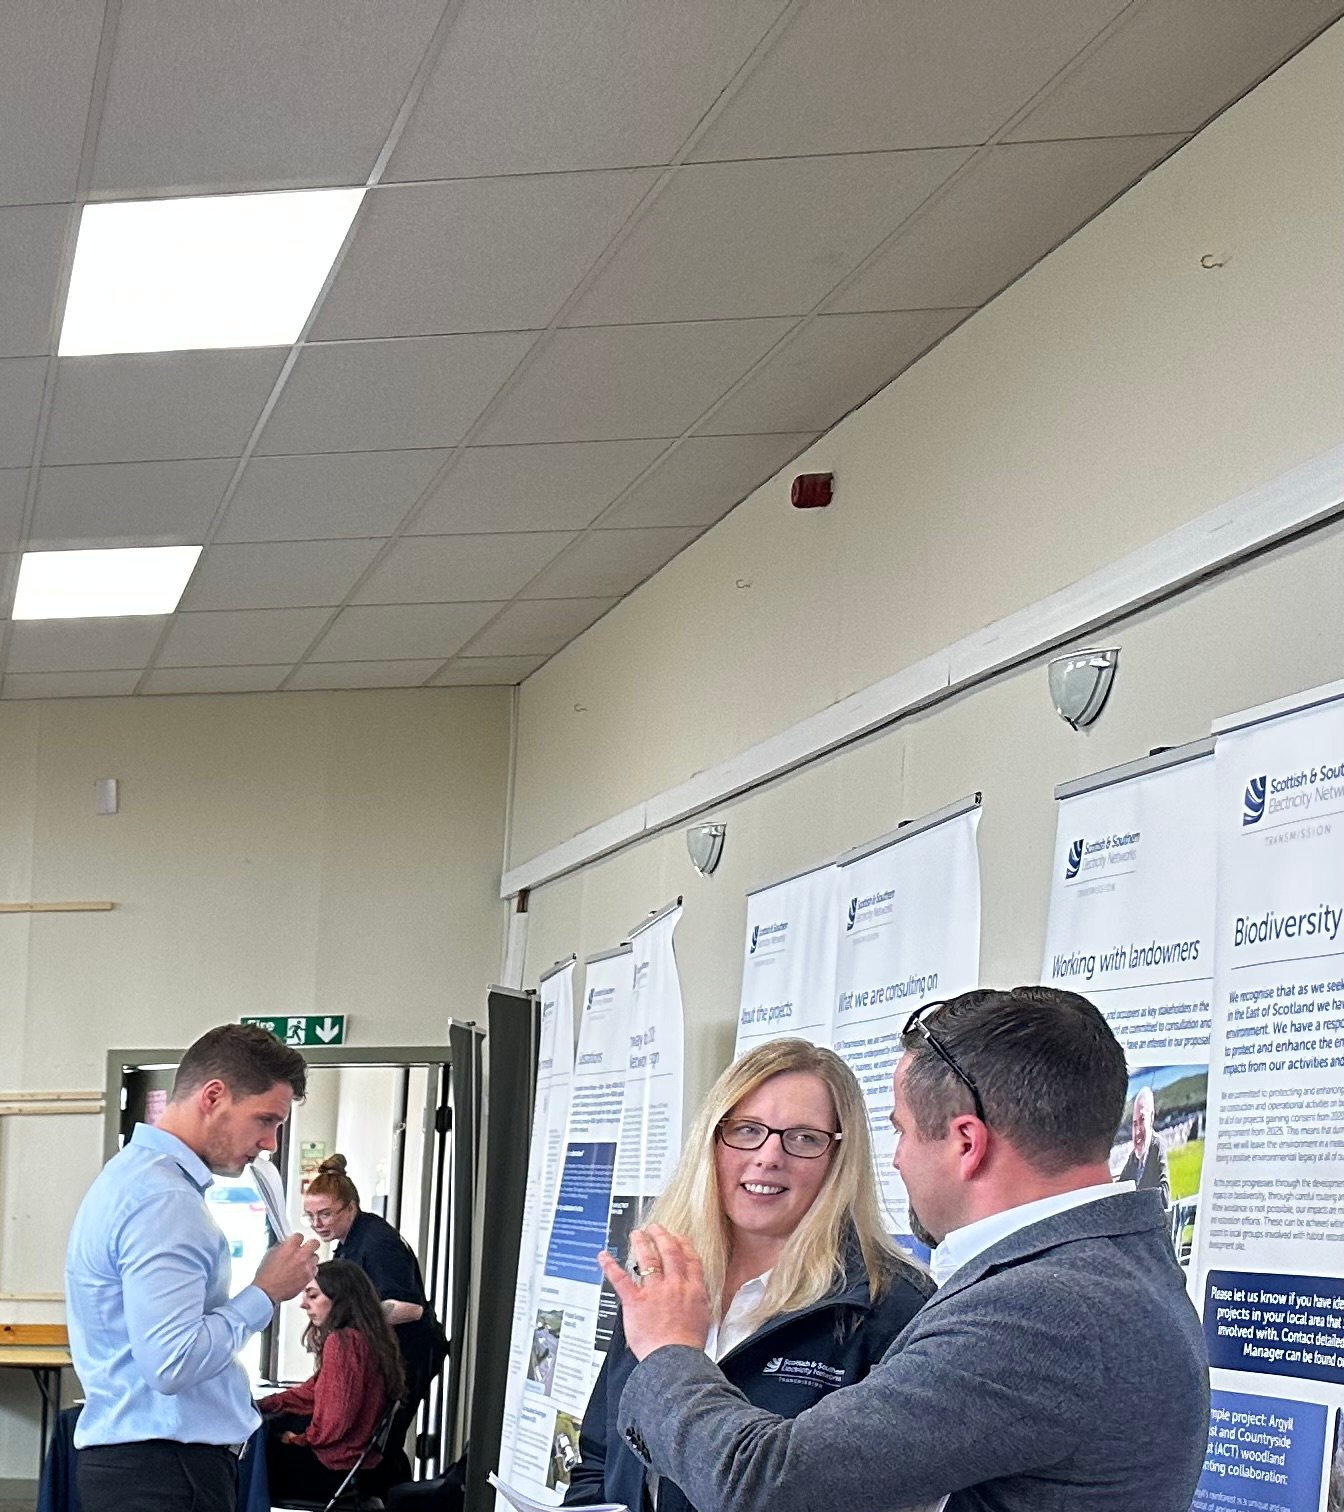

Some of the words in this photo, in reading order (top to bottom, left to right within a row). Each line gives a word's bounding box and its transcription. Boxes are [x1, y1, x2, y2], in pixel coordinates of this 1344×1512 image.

[1270, 771, 1307, 794] Scottish
[1309, 767, 1318, 784] &
[1268, 791, 1312, 815] Electricity
[1264, 824, 1332, 847] TRANSMISSION
[1234, 903, 1343, 947] Biodiversity
[1052, 950, 1096, 980] Working
[1099, 944, 1126, 973] with
[1128, 939, 1201, 969] landowners
[854, 993, 869, 1008] we
[870, 989, 885, 1006] are
[885, 975, 925, 1001] consulting
[926, 972, 938, 991] on
[1276, 984, 1295, 997] that
[1297, 985, 1309, 995] as
[1310, 982, 1325, 993] we
[1261, 1004, 1271, 1018] of
[1272, 1000, 1314, 1017] Scotland
[1316, 1001, 1330, 1012] we
[1272, 1021, 1287, 1035] We
[1289, 1020, 1313, 1033] have
[1256, 1040, 1273, 1054] and
[1275, 1038, 1316, 1053] enhance
[1318, 1036, 1332, 1050] the
[1247, 1060, 1267, 1073] from
[1268, 1060, 1286, 1072] our
[1287, 1056, 1329, 1071] activities
[1210, 1285, 1233, 1301] Please
[1233, 1287, 1246, 1302] let
[1247, 1290, 1259, 1303] us
[1260, 1289, 1288, 1305] know
[1288, 1291, 1296, 1306] if
[1296, 1295, 1312, 1309] you
[1313, 1293, 1332, 1309] have
[1216, 1305, 1250, 1321] projects
[1251, 1306, 1261, 1321] in
[1262, 1311, 1286, 1325] your
[1286, 1310, 1308, 1326] local
[1308, 1315, 1325, 1327] area
[1326, 1314, 1342, 1329] that
[1217, 1321, 1254, 1339] involved
[1255, 1326, 1279, 1341] with.
[1281, 1327, 1314, 1345] Contact
[1242, 1342, 1285, 1362] Manager
[1285, 1349, 1301, 1362] can
[1302, 1348, 1313, 1363] be
[1313, 1350, 1337, 1367] found
[1231, 1410, 1267, 1427] project:
[1268, 1414, 1294, 1432] Argyll
[1218, 1426, 1236, 1440] and
[1237, 1427, 1292, 1449] Countryside
[1214, 1441, 1239, 1459] (ACT)
[1240, 1448, 1286, 1466] woodland
[1227, 1463, 1288, 1485] collaboration:
